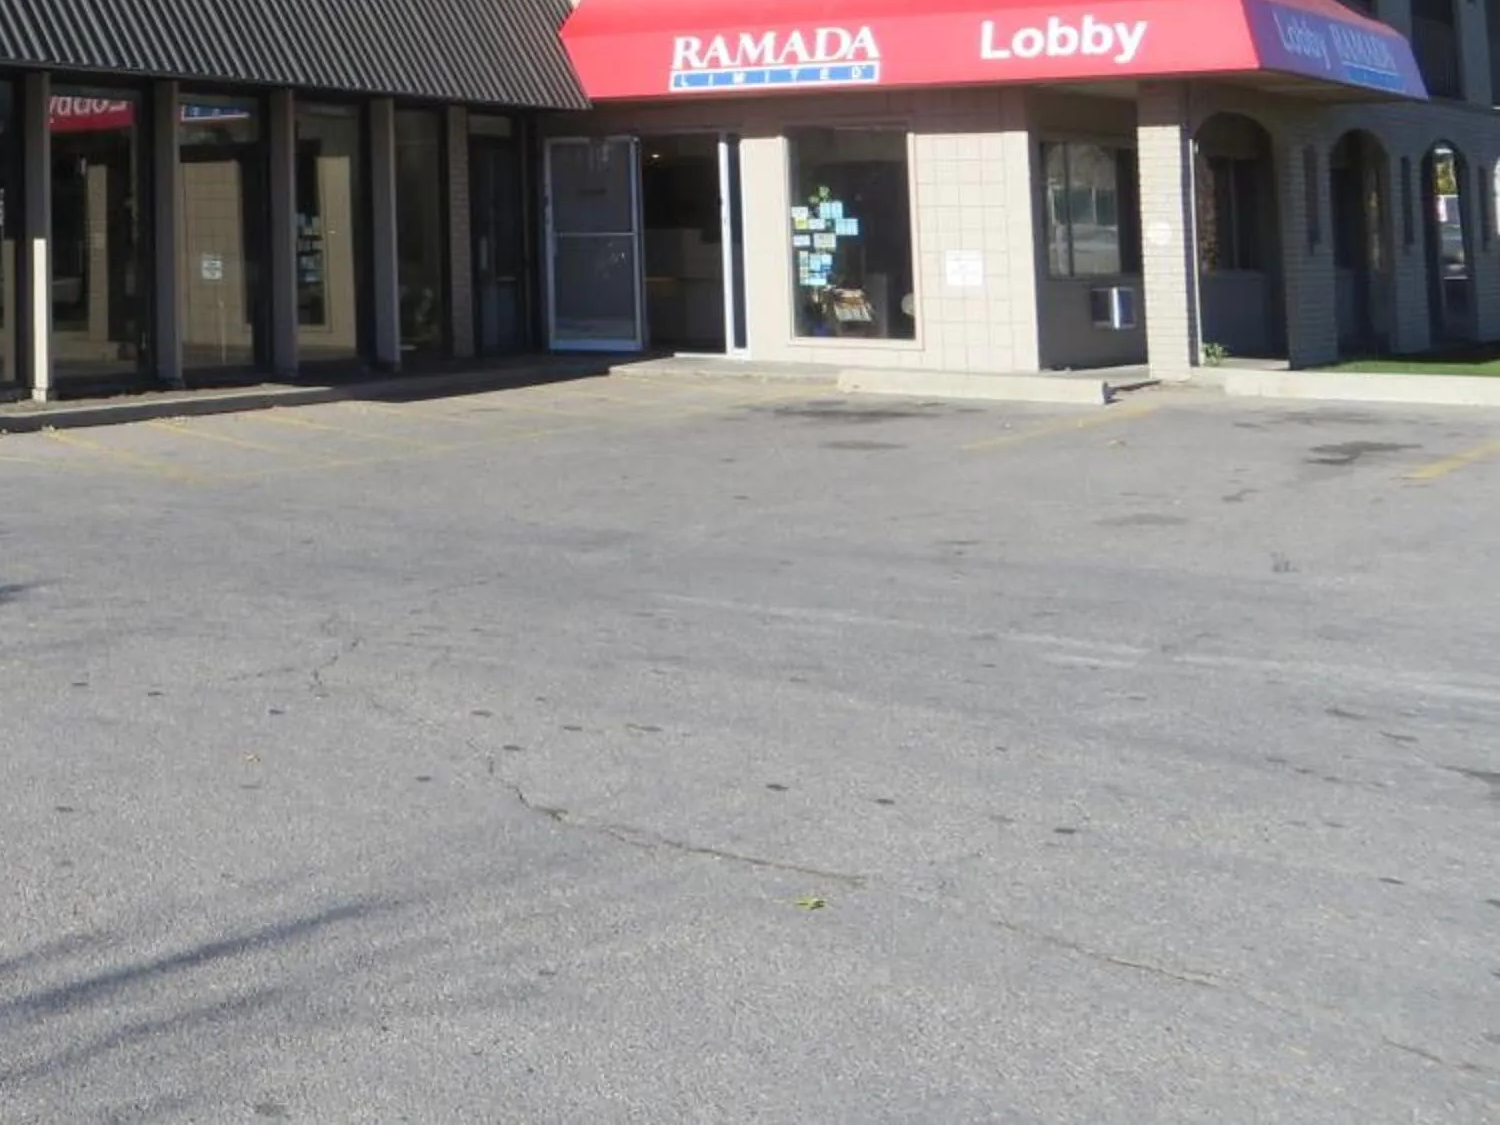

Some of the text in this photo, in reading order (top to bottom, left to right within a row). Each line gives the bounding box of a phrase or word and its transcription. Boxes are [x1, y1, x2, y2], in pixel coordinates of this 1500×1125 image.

[671, 24, 880, 69] RAMADA
[981, 14, 1149, 64] Lobby
[679, 64, 864, 88] LIMITED
